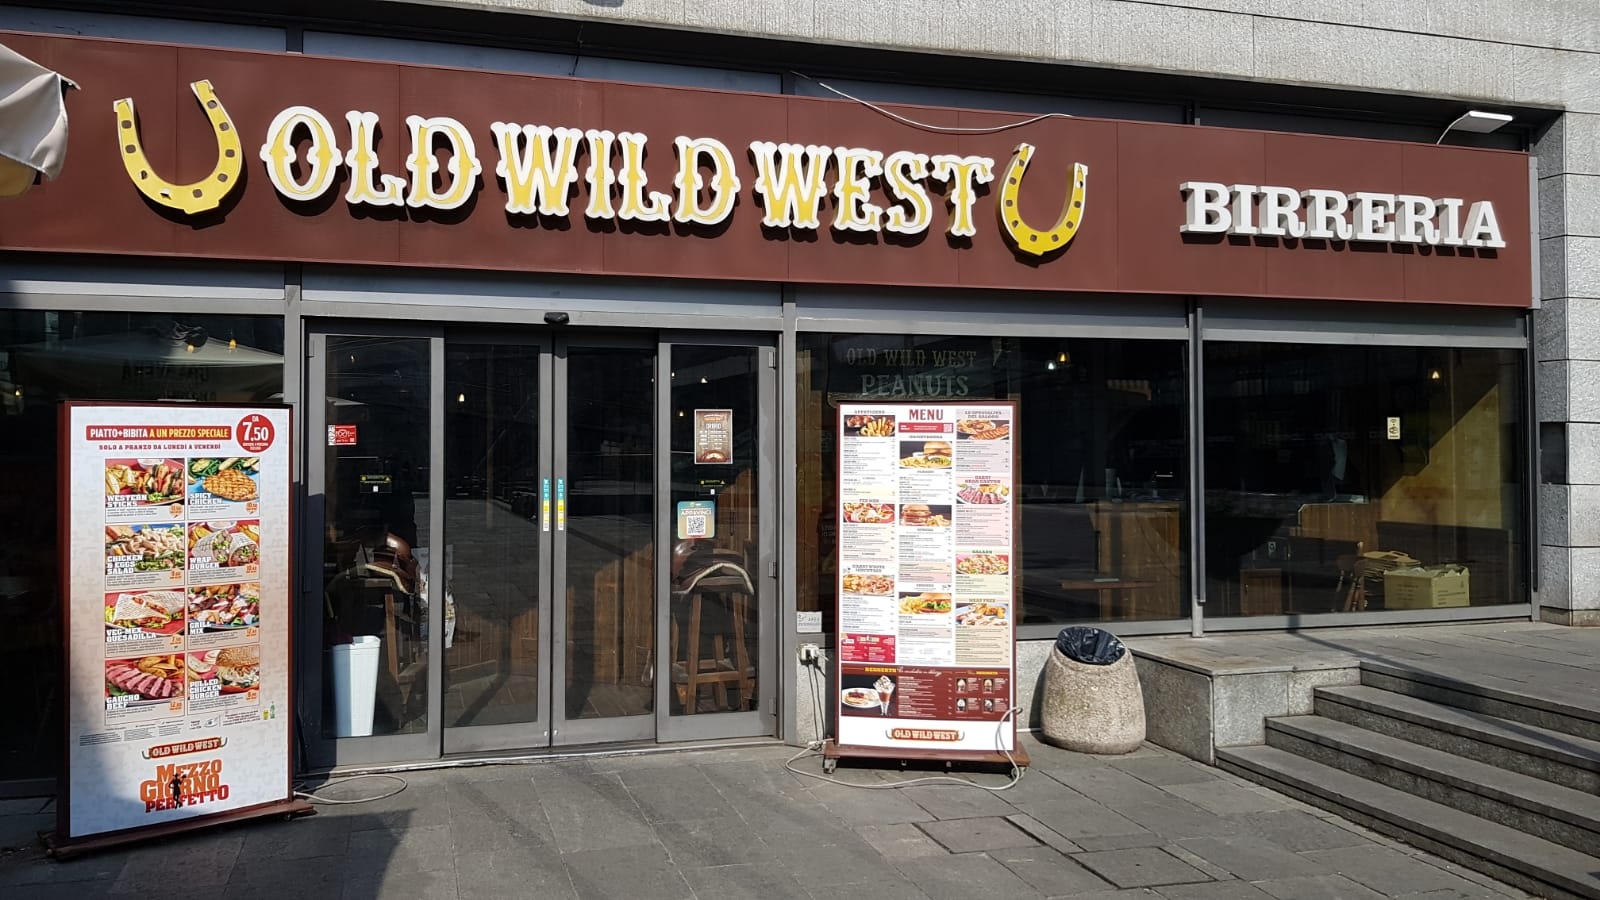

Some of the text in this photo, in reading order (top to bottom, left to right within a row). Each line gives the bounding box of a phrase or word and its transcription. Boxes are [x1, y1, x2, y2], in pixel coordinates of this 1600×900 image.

[260, 105, 995, 237] OLD WILD WEST
[1179, 181, 1506, 249] BIRRERIA
[846, 348, 976, 368] OLD WILD WEST
[861, 374, 969, 396] PEANUTS
[909, 409, 944, 420] MENU
[90, 428, 228, 438] PIATTO+BIBITA A UN PREZZO SPECIALE
[242, 422, 269, 442] 7.50
[106, 633, 157, 642] QUESADILLA
[190, 679, 219, 687] PULLED
[190, 685, 221, 693] CHICKEN
[106, 694, 139, 703] GAUCHO
[190, 690, 220, 700] BURGER
[107, 701, 128, 710] BEEF
[895, 730, 957, 740] OLD WILD WEST
[152, 739, 219, 756] OLD WILD WEST
[156, 760, 222, 784] MEZZO
